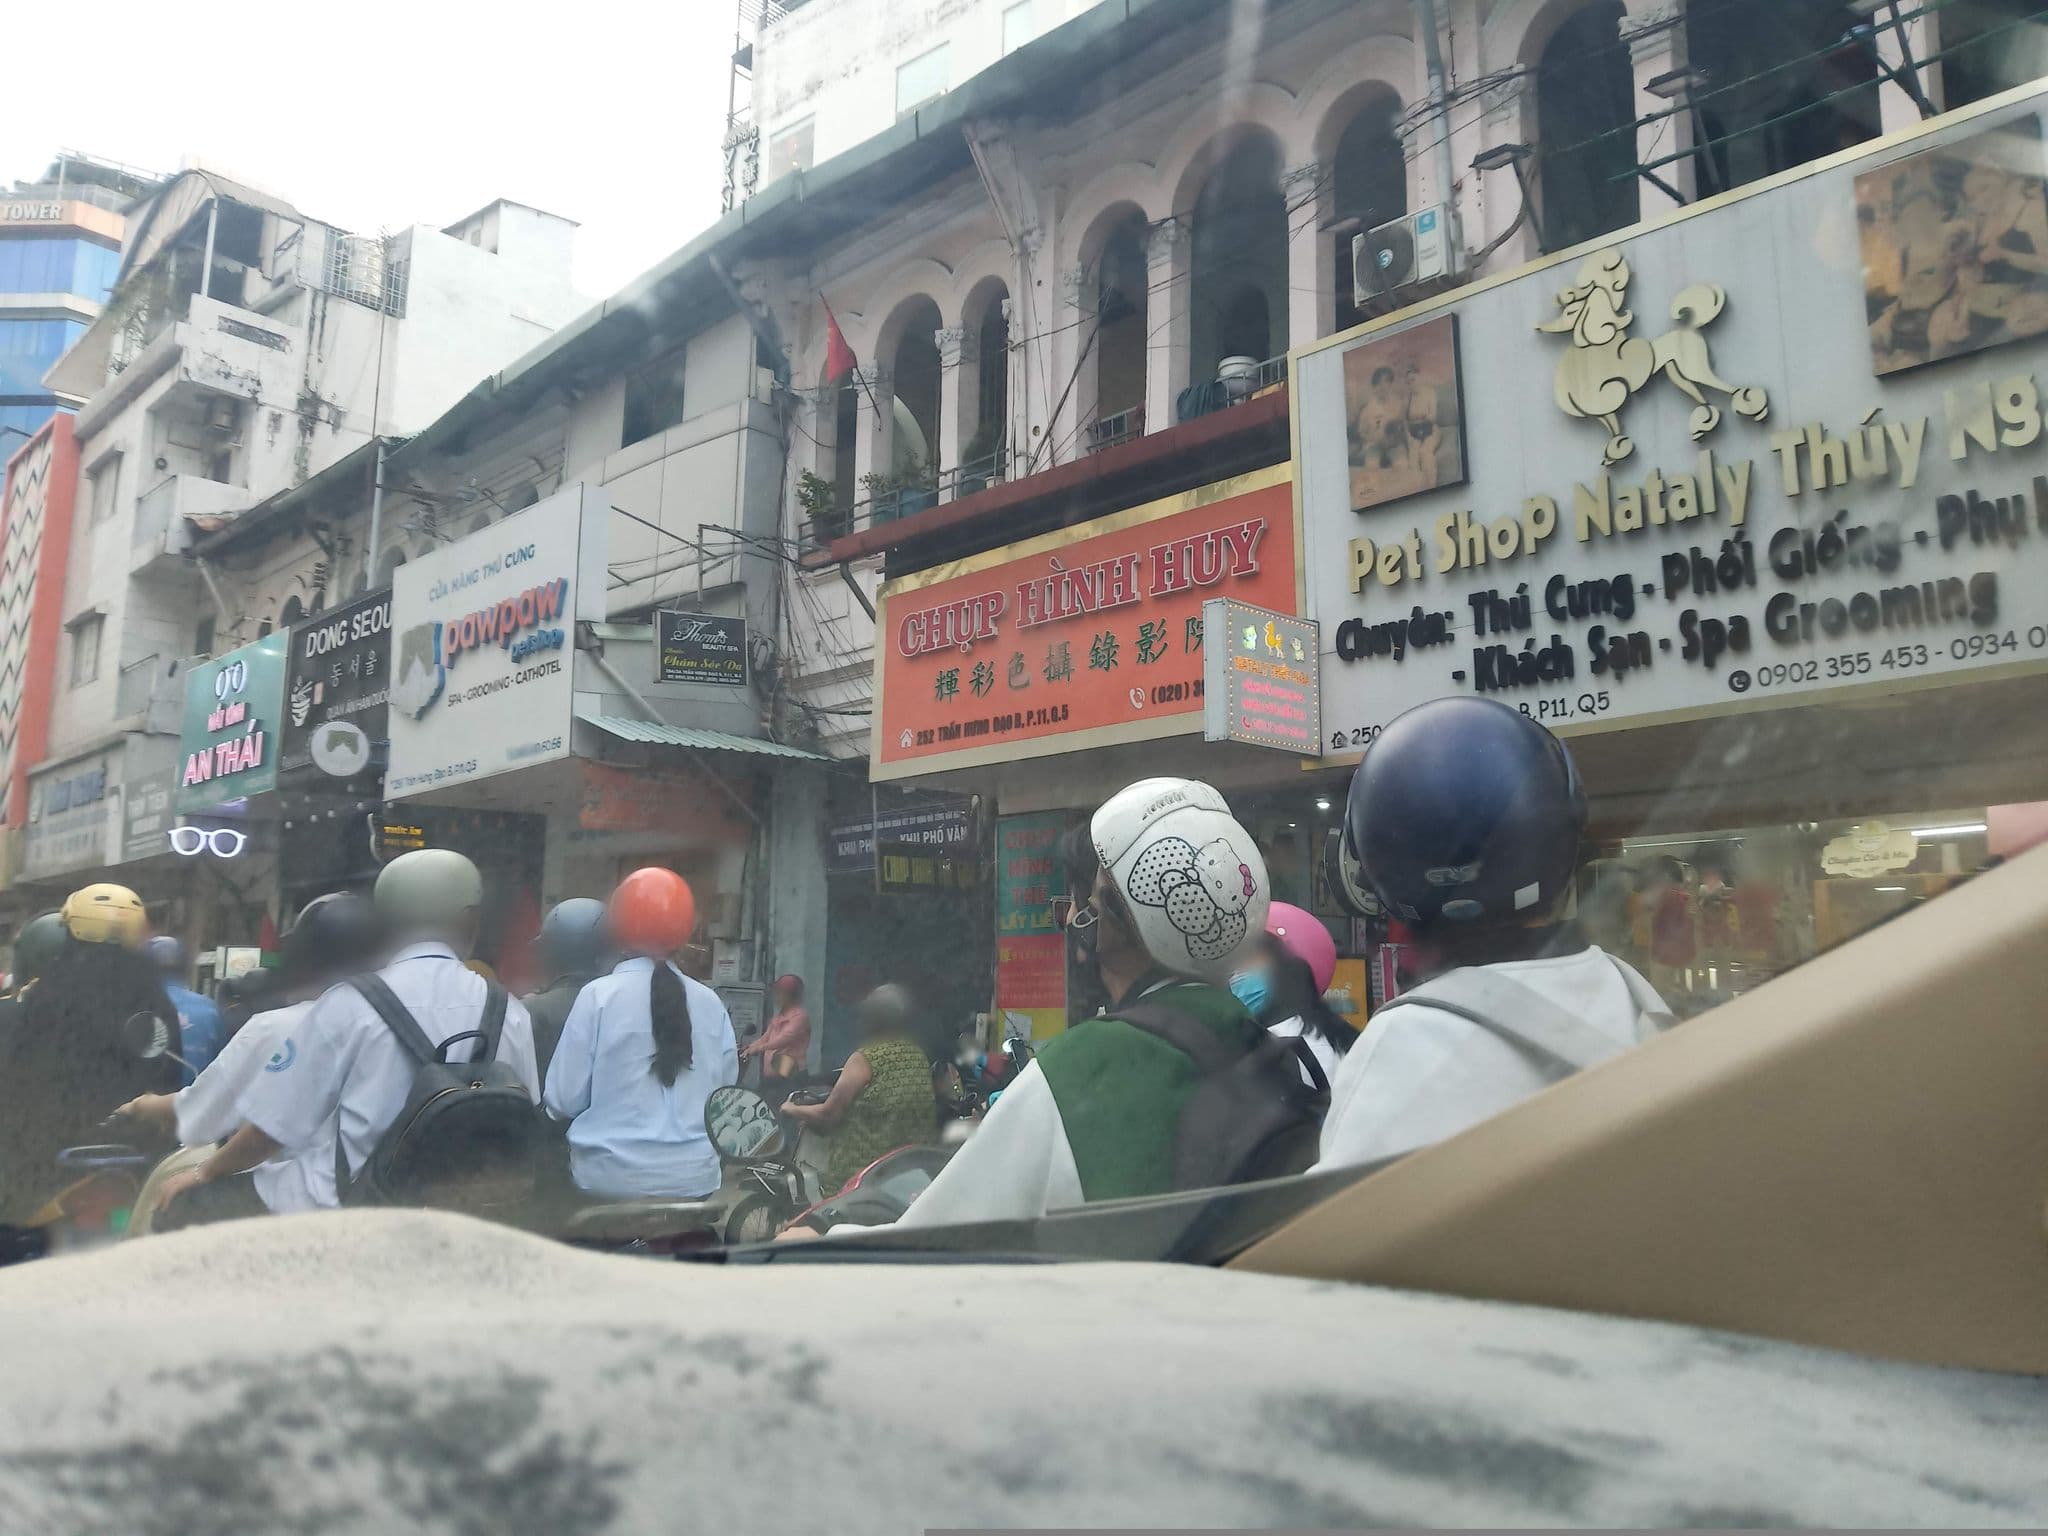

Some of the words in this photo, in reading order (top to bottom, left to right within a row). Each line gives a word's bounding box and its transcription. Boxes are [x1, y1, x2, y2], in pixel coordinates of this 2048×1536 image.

[3, 204, 62, 220] TOWER
[1350, 528, 1423, 595] Pet
[1574, 447, 1753, 544] Nataly
[1770, 408, 1930, 498] Thúy
[1942, 374, 2048, 463] Ng
[899, 591, 1006, 656] CHỤP
[1016, 555, 1142, 629] HÌNH
[1149, 517, 1266, 597] HUY
[1467, 582, 1534, 637] Thú
[306, 619, 348, 658] DONG
[445, 577, 567, 670] pawpaw
[1473, 634, 1575, 692] Khách
[1679, 608, 1751, 670] Spa
[1765, 571, 1999, 647] Grooming
[515, 659, 562, 685] CATHOTEL
[1757, 660, 1819, 687] 0902
[1826, 652, 1871, 678] 355
[1880, 644, 1929, 670] 453
[1950, 629, 2019, 660] 0934
[2027, 624, 2048, 649] 0
[1193, 679, 1205, 698] 3
[182, 753, 213, 787] AN
[216, 718, 264, 777] THÁI
[917, 728, 935, 746] 252
[923, 823, 944, 844] PHỐ
